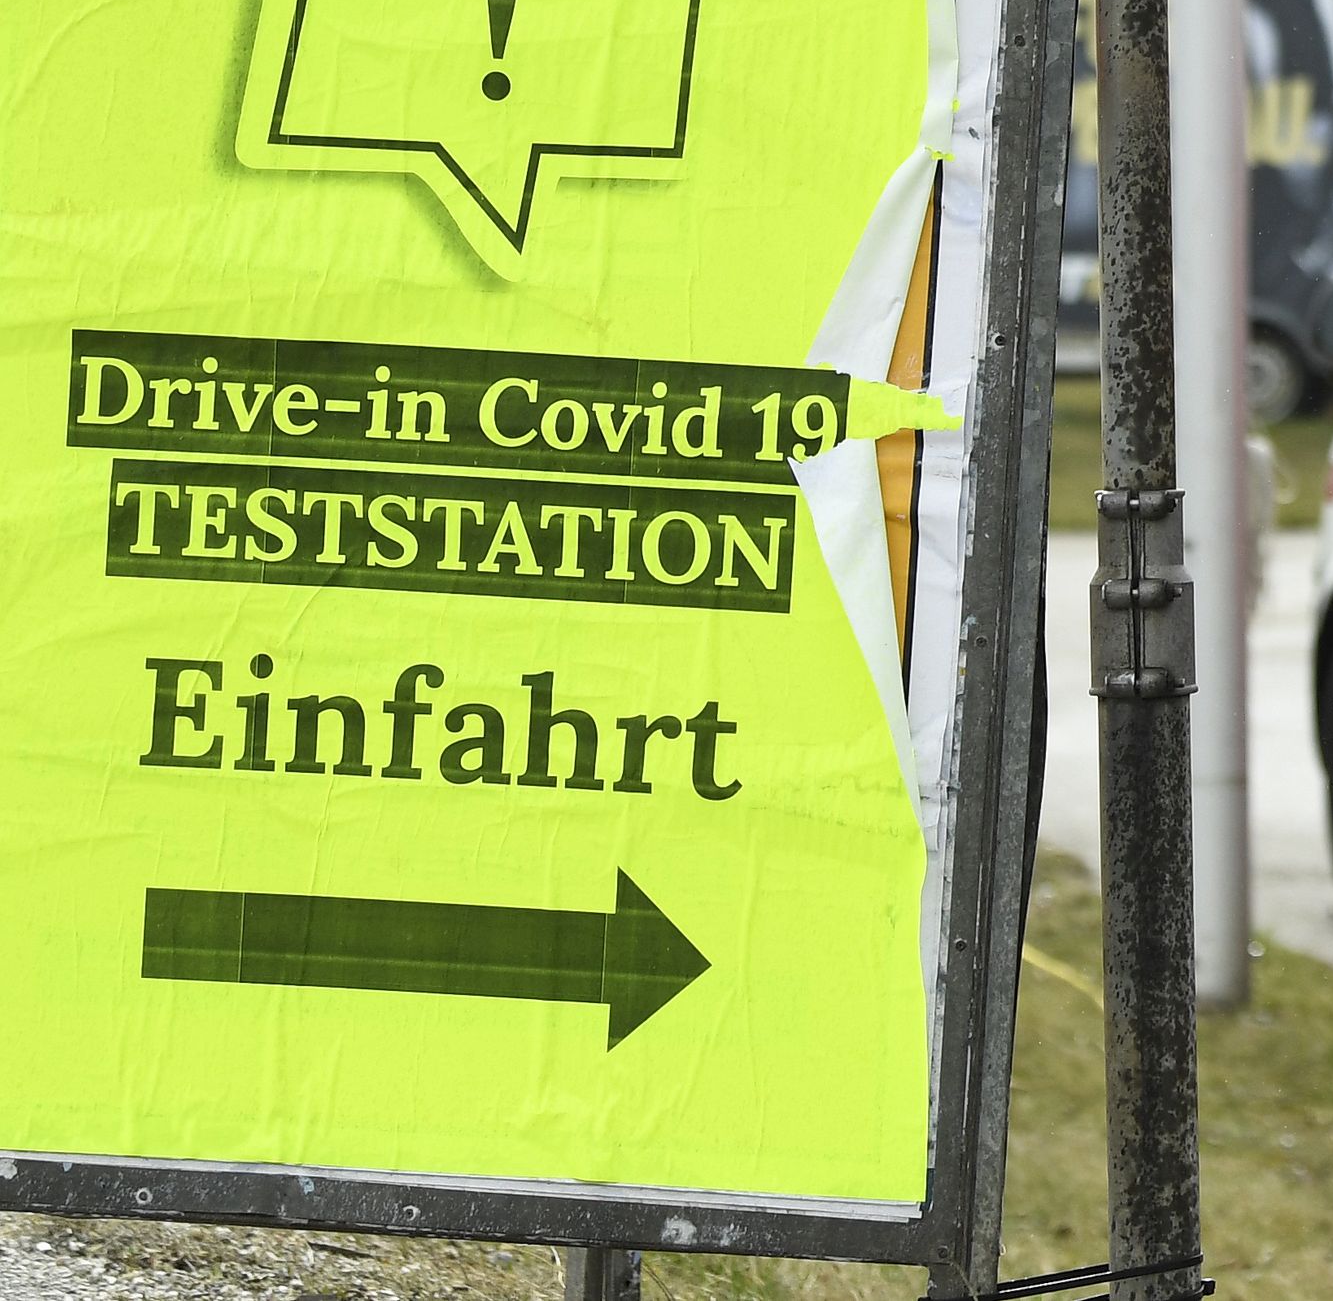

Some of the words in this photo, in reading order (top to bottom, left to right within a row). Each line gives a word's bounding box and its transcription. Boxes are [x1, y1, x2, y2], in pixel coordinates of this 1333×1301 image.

[77, 356, 450, 443] Drive-in
[479, 377, 722, 459] Covid
[751, 392, 838, 464] 19
[115, 482, 787, 590] TESTSTATION
[139, 654, 742, 801] Einfahrt
